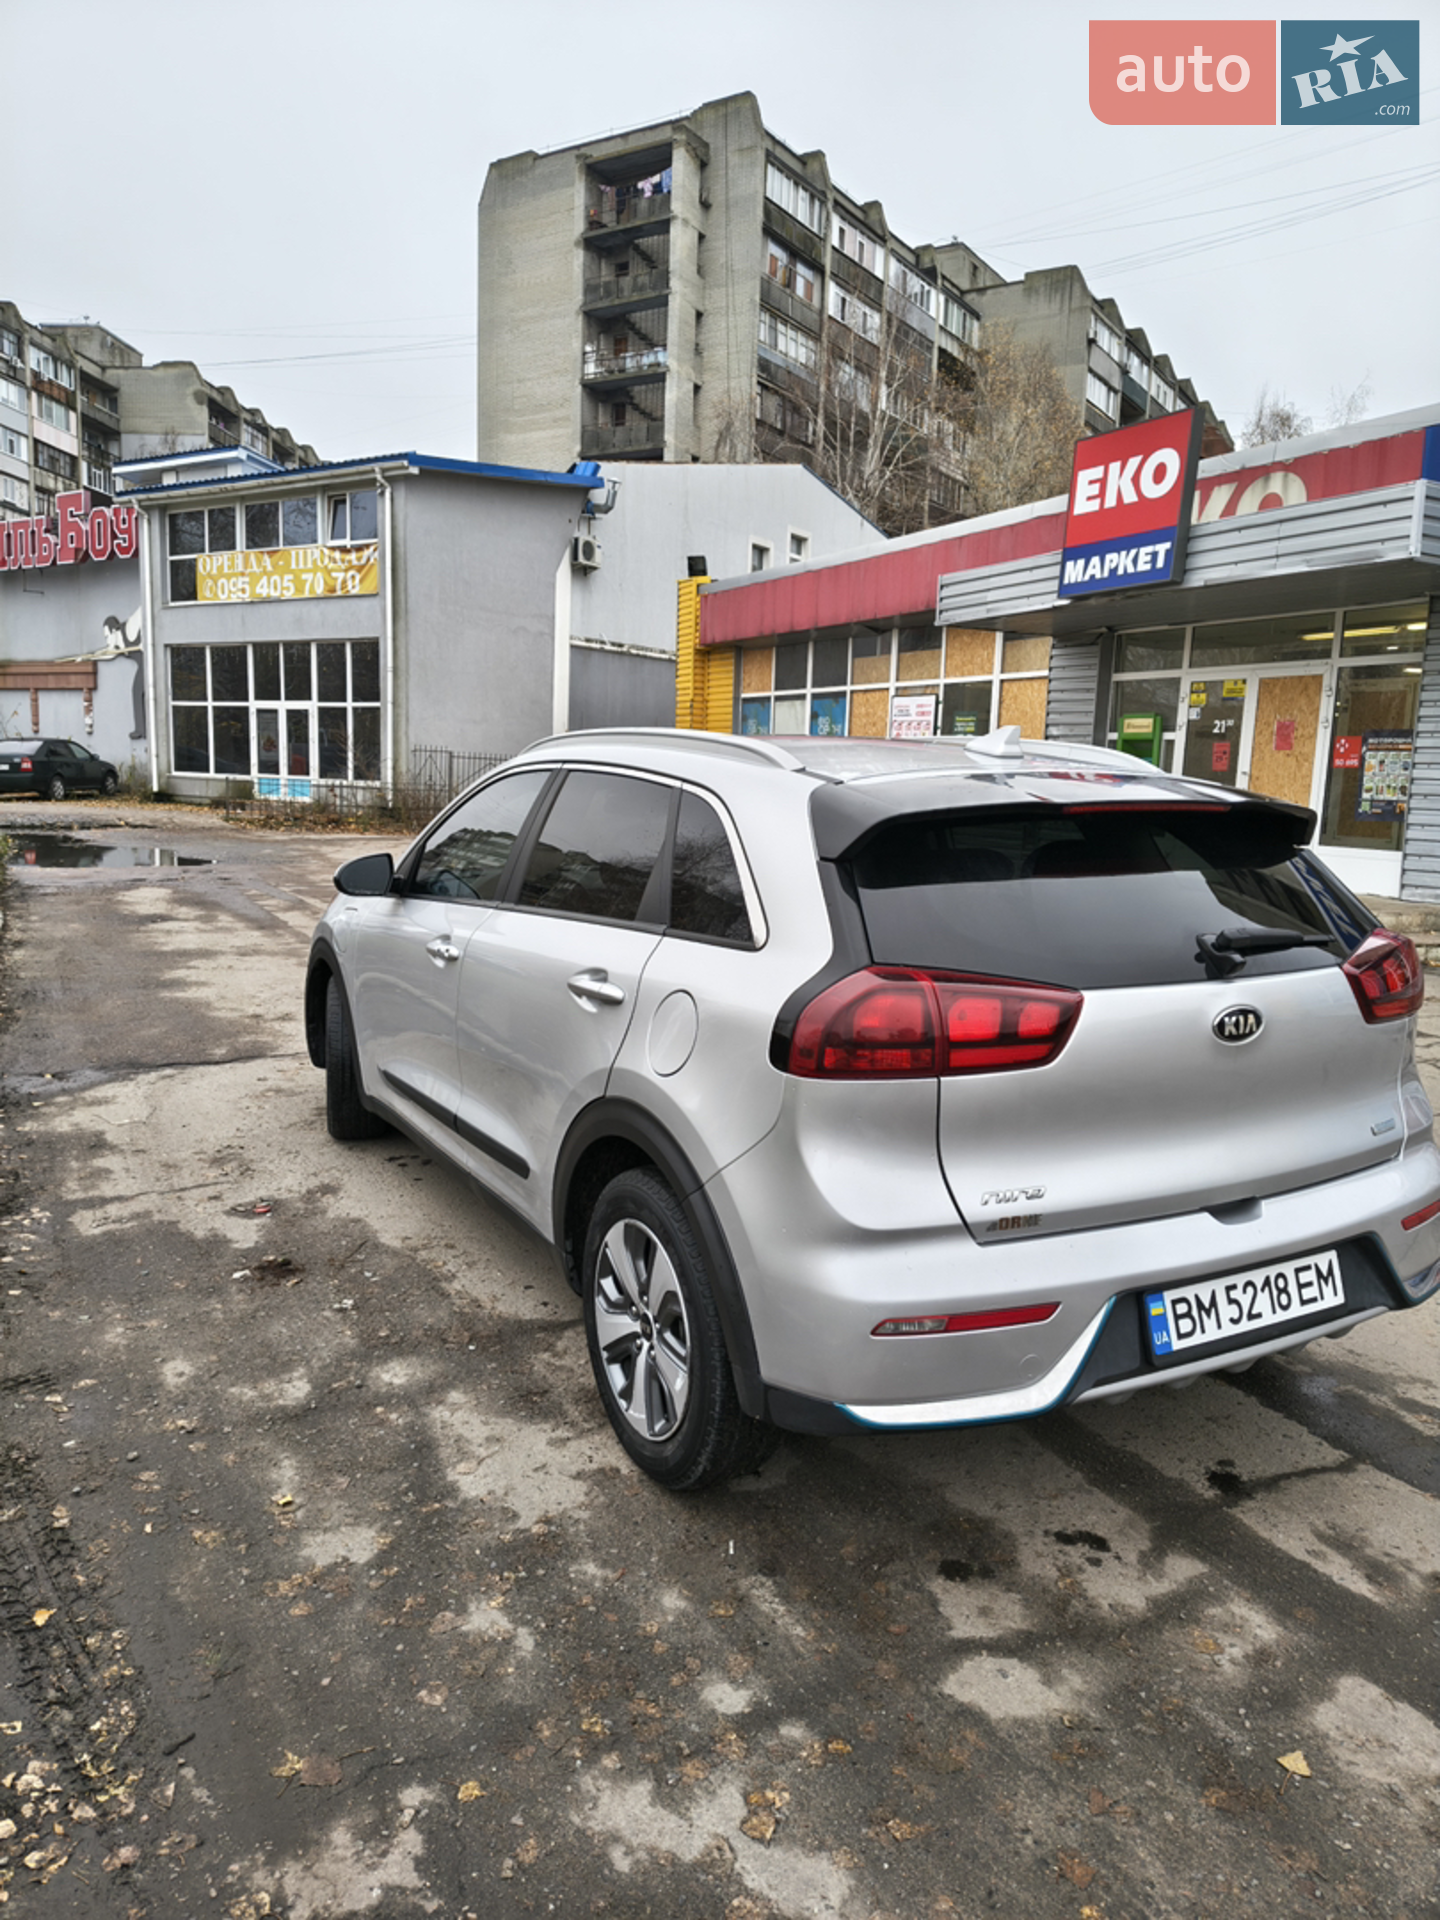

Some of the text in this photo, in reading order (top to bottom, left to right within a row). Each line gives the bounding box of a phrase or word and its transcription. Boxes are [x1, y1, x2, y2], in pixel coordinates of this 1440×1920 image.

[1072, 447, 1181, 516] ЕКО
[199, 551, 274, 576] ОРЕНДА
[1063, 541, 1172, 585] МАРКЕТ
[216, 577, 250, 600] 095
[255, 574, 295, 598] 405
[301, 572, 324, 595] 70
[1223, 1013, 1257, 1036] KIA
[1170, 1258, 1338, 1341] BM 5218 EM
[1153, 1330, 1170, 1345] UA
